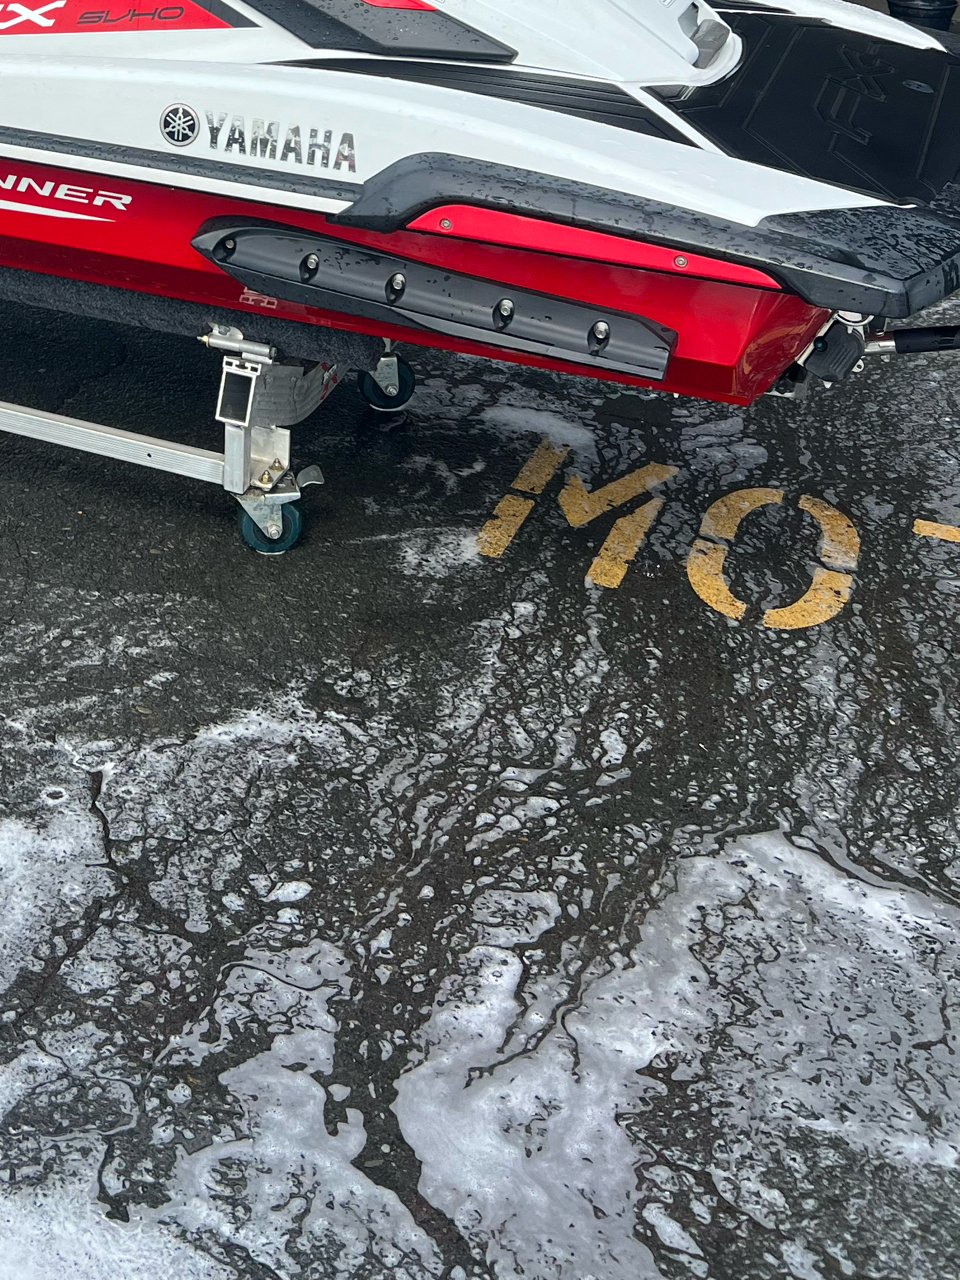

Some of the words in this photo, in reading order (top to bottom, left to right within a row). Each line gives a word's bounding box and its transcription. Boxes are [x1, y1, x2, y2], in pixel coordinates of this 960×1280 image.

[77, 6, 185, 25] SVHO
[204, 109, 357, 174] YAMAHA
[477, 438, 960, 629] MO
